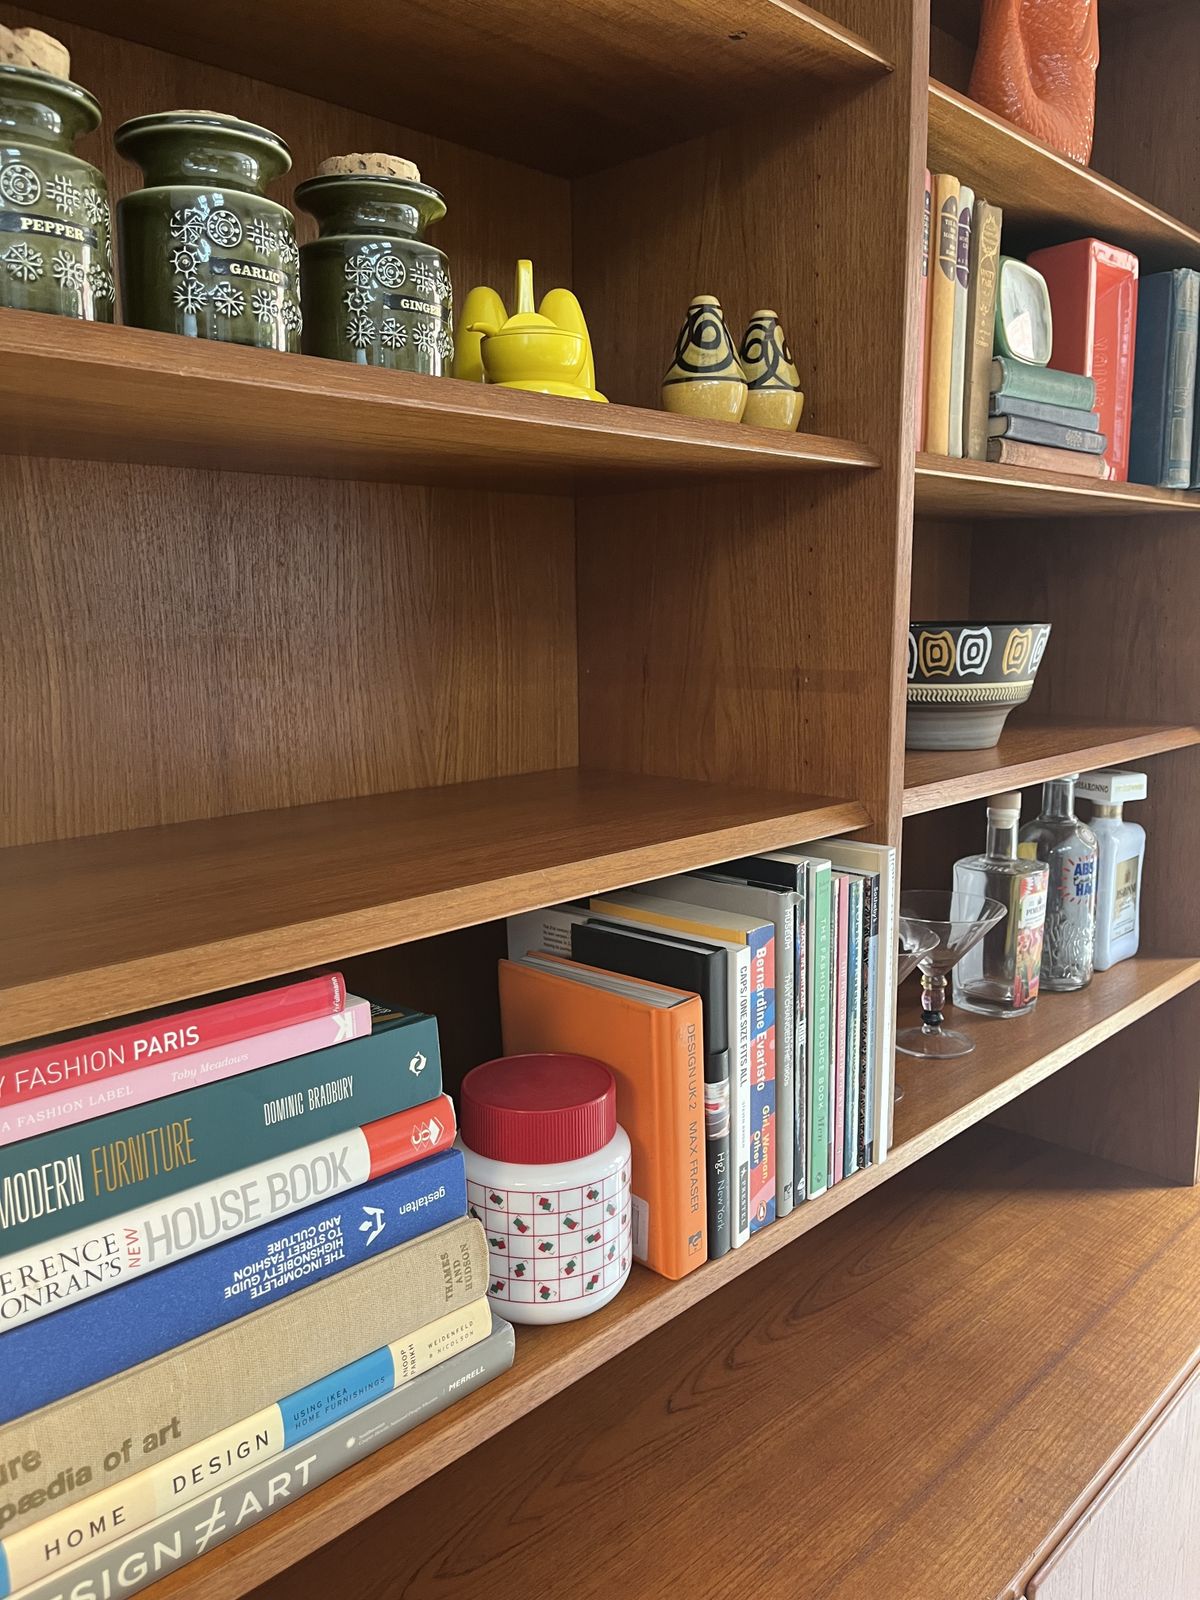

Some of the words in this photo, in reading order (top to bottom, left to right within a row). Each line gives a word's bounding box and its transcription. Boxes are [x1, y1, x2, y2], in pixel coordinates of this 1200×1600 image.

[20, 216, 84, 241] PEPPER
[229, 261, 281, 284] GARLIC
[872, 886, 880, 922] Sotheby's
[819, 917, 827, 942] THE
[740, 965, 748, 994] CAPS
[755, 946, 768, 1029] Bernardine
[819, 947, 827, 1002] FASHION
[740, 999, 748, 1020] ONE
[740, 1019, 748, 1043] SIZE
[818, 1007, 826, 1073] RESOURCE
[15, 1045, 125, 1093] FASHION
[133, 1025, 200, 1060] PARIS
[687, 1023, 697, 1079] DESIGN
[740, 1043, 748, 1067] FITS
[756, 1031, 768, 1092] Evaristo
[171, 1070, 198, 1084] Toby
[199, 1054, 249, 1075] Meadows
[740, 1067, 748, 1087] ALL
[264, 1092, 304, 1126] DOMINIC
[308, 1075, 354, 1111] BRADBURY
[688, 1079, 697, 1101] UK
[817, 1077, 826, 1111] BOOK
[1, 1121, 11, 1133] A
[17, 1099, 83, 1128] FASHION
[89, 1085, 134, 1107] LABEL
[688, 1102, 697, 1111] 2
[762, 1105, 770, 1132] Girl,
[688, 1121, 699, 1157] MAX
[816, 1115, 825, 1143] Men
[714, 1151, 725, 1175] Hg2
[752, 1130, 761, 1165] Other
[761, 1133, 770, 1184] Woman,
[0, 1154, 85, 1229] MODERN
[91, 1118, 197, 1197] FURNITURE
[688, 1159, 699, 1213] FRASER
[144, 1180, 262, 1262] HOUSE
[269, 1146, 353, 1213] BOOK
[399, 1186, 446, 1215] gestalten
[717, 1179, 725, 1205] New
[318, 1215, 341, 1232] AND
[327, 1227, 343, 1240] TO
[717, 1205, 725, 1231] York
[123, 1228, 141, 1268] NEW
[267, 1226, 316, 1255] CULTURE
[286, 1233, 326, 1259] STREET
[0, 1233, 120, 1296] ERENCE
[233, 1251, 285, 1282] FASHION
[263, 1237, 344, 1281] HIGHSNOBIETY
[324, 1249, 345, 1266] THE
[453, 1260, 463, 1283] AND
[460, 1243, 472, 1291] HUDSON
[224, 1274, 260, 1299] GUIDE
[250, 1258, 322, 1299] INCOMPLETE
[440, 1252, 453, 1302] THAMES
[428, 1320, 475, 1349] WEIDENFELD
[437, 1330, 475, 1354] NICOLSON
[400, 1349, 409, 1378] ANOOP
[408, 1343, 416, 1376] PARIKH
[448, 1365, 486, 1392] MERRELL
[293, 1400, 323, 1421] USING
[326, 1387, 348, 1403] IKEA
[295, 1411, 320, 1430] HOME
[324, 1375, 386, 1414] FURNISHINGS
[103, 1438, 133, 1472] of
[143, 1416, 182, 1454] art
[45, 1506, 126, 1561] HOME
[172, 1430, 270, 1495] DESIGN
[50, 1530, 182, 1600] SIGN
[235, 1454, 318, 1525] ART
